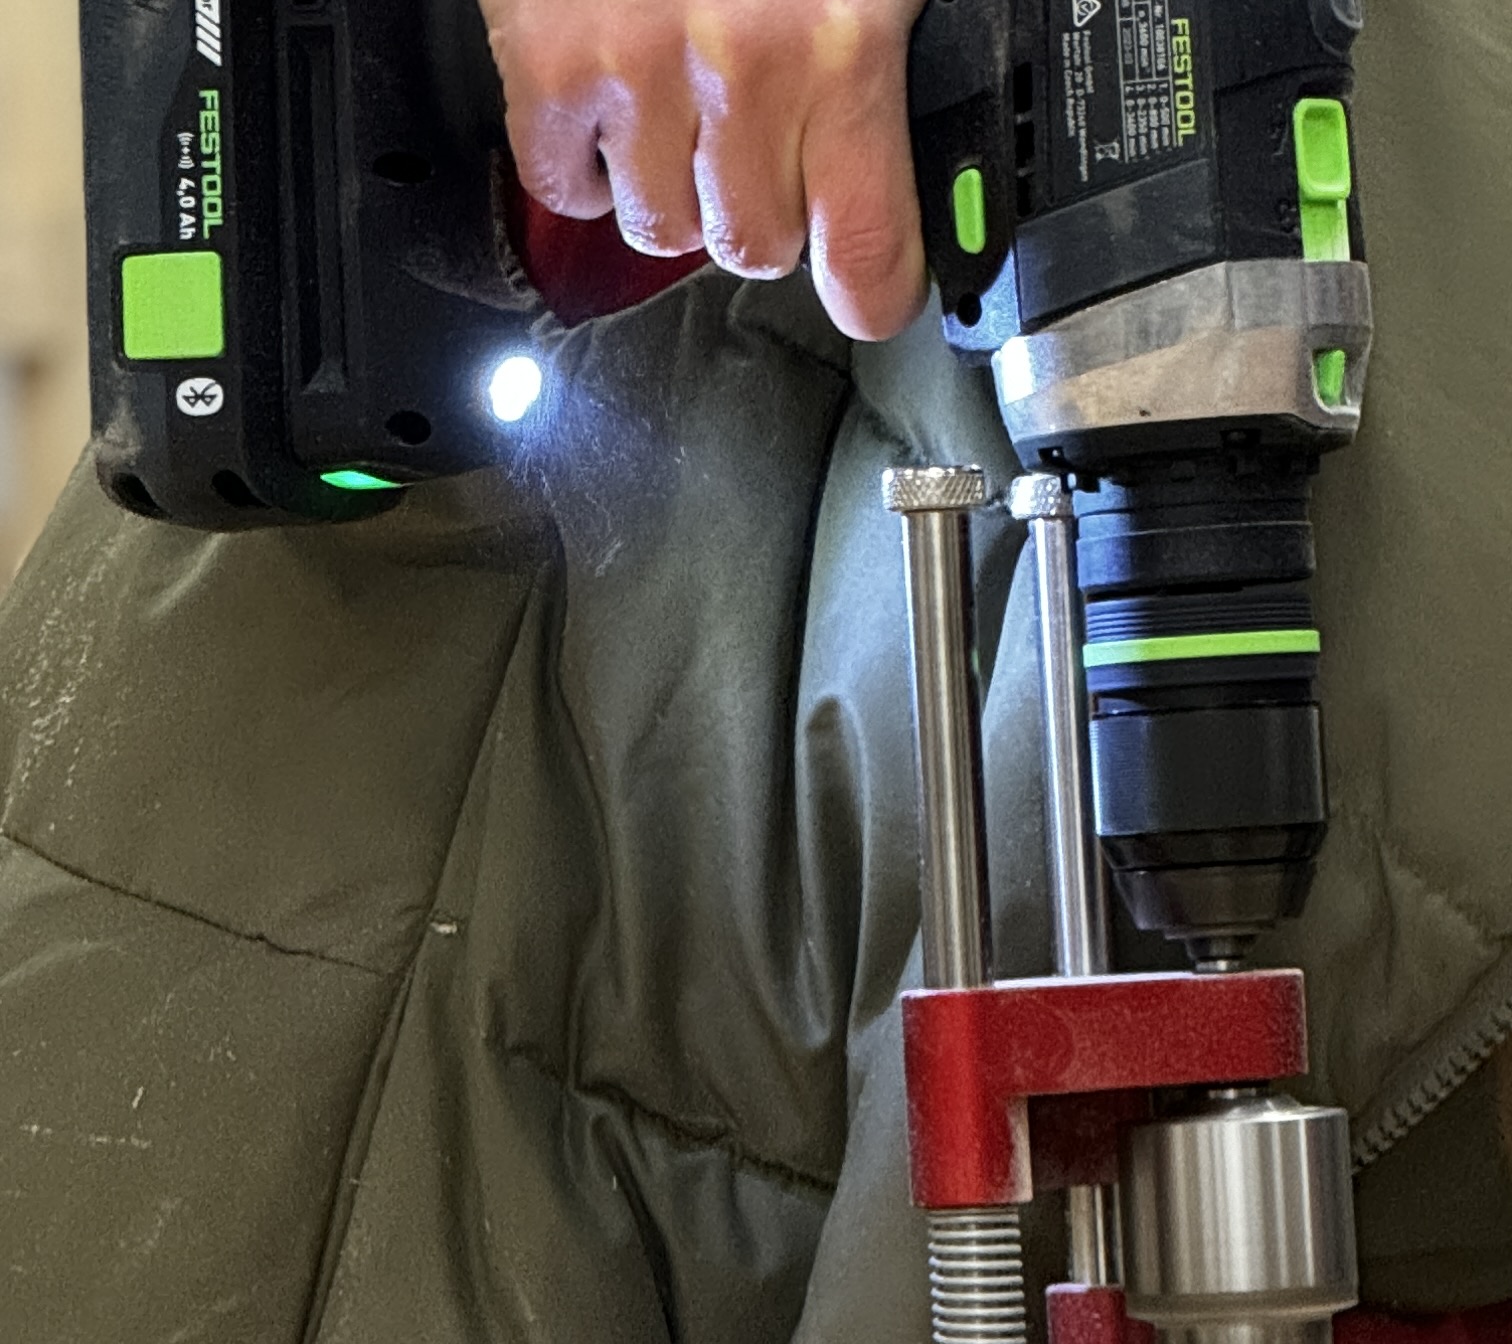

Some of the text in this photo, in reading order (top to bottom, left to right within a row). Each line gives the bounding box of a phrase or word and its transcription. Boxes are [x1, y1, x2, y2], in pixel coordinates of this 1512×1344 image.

[1171, 18, 1196, 147] FESTOOL
[176, 177, 197, 240] 4,0 Ah
[199, 90, 223, 239] FESTOOL
